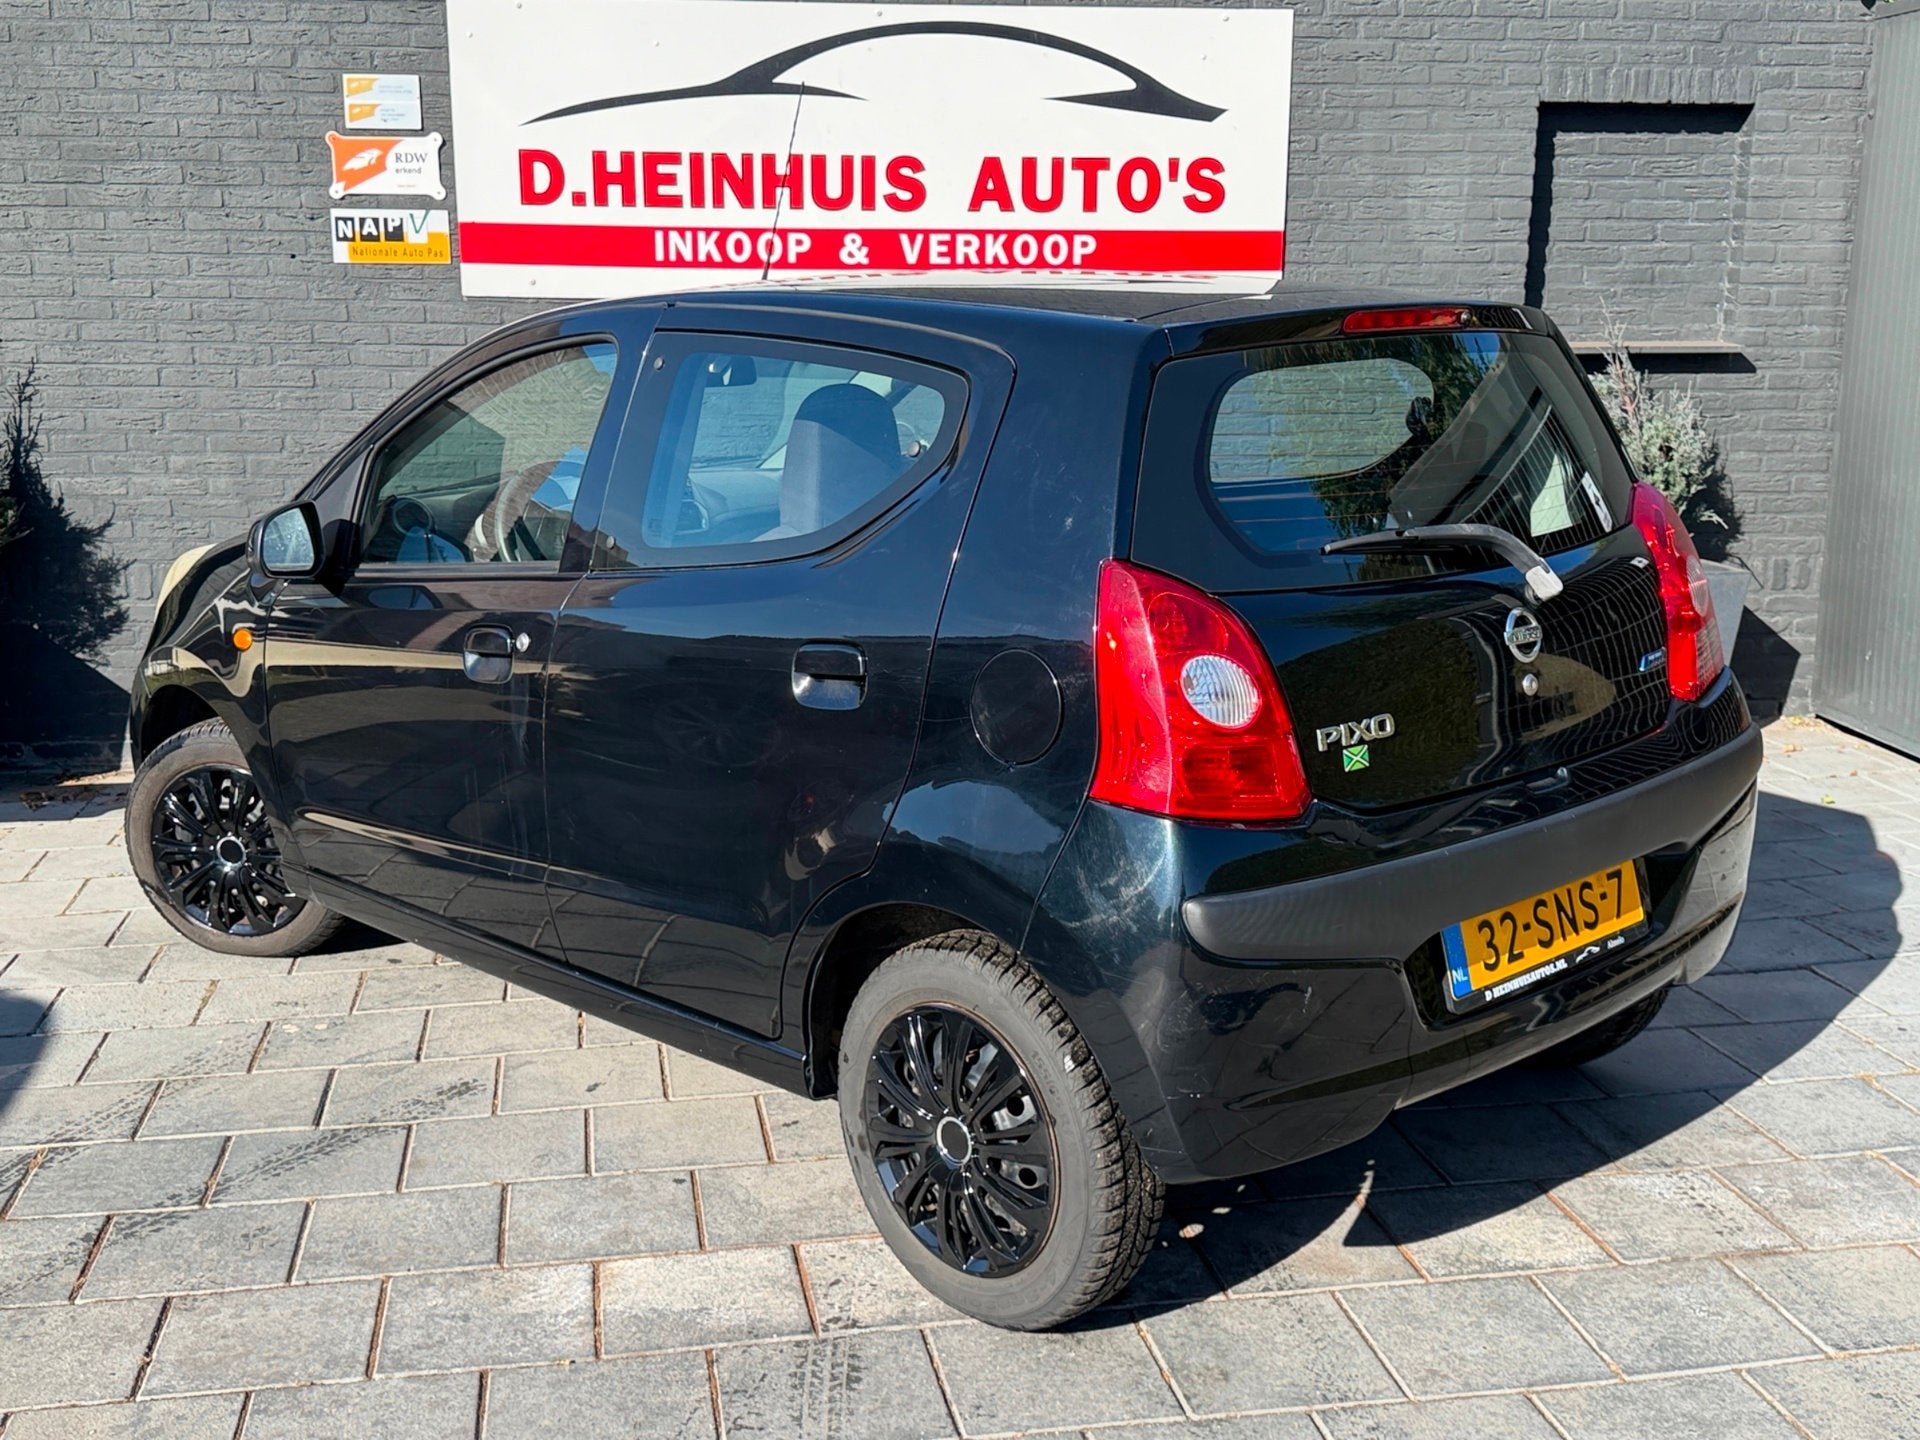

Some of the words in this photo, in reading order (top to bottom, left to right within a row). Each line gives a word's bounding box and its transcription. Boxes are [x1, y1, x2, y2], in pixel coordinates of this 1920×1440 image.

[394, 152, 428, 164] RDW
[395, 166, 423, 175] erkend
[518, 148, 928, 212] D.HEINHUIS
[967, 156, 1227, 214] AUTO'S
[352, 247, 398, 257] Nationale
[402, 248, 424, 257] Auto
[427, 248, 444, 258] Pas
[654, 229, 812, 264] INKOOP
[838, 232, 869, 265] &
[898, 232, 1097, 267] VERKOOP
[1316, 713, 1396, 752] PIXO
[1477, 868, 1623, 972] 32-SNS-7
[1451, 965, 1469, 983] NL
